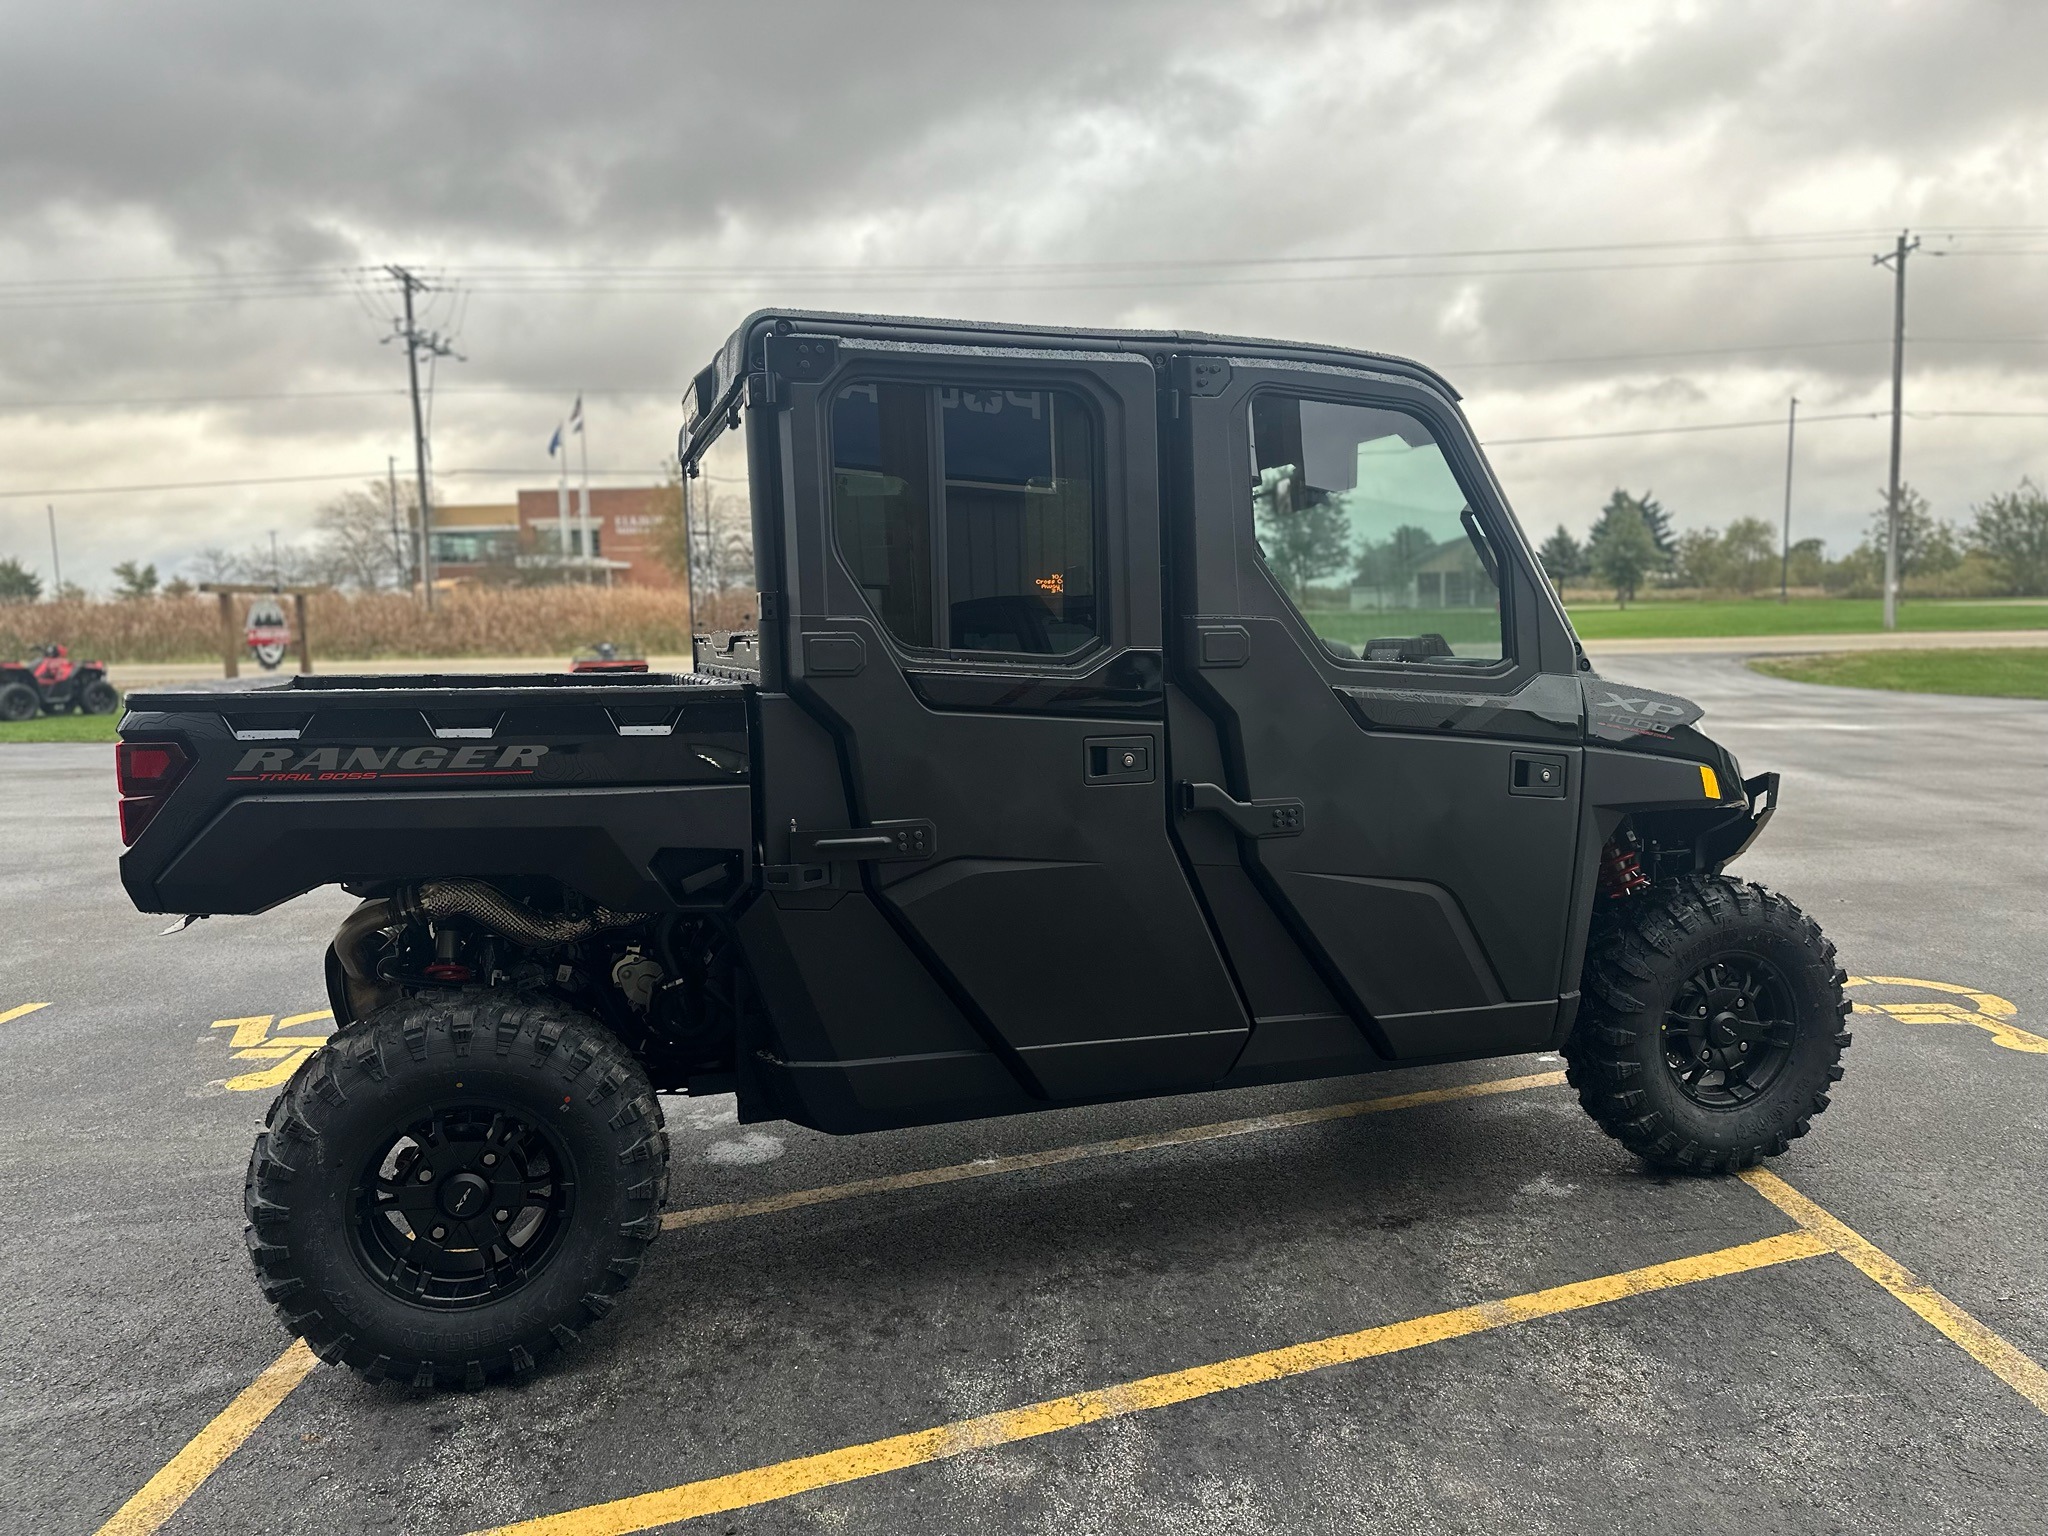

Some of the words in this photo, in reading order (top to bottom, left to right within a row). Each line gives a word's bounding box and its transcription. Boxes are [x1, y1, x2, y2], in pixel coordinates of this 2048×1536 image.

[1596, 692, 1684, 716] XP
[1608, 713, 1671, 733] 1000
[232, 744, 550, 772] RANGER
[258, 772, 315, 781] TRAIL
[318, 772, 378, 781] BOSS
